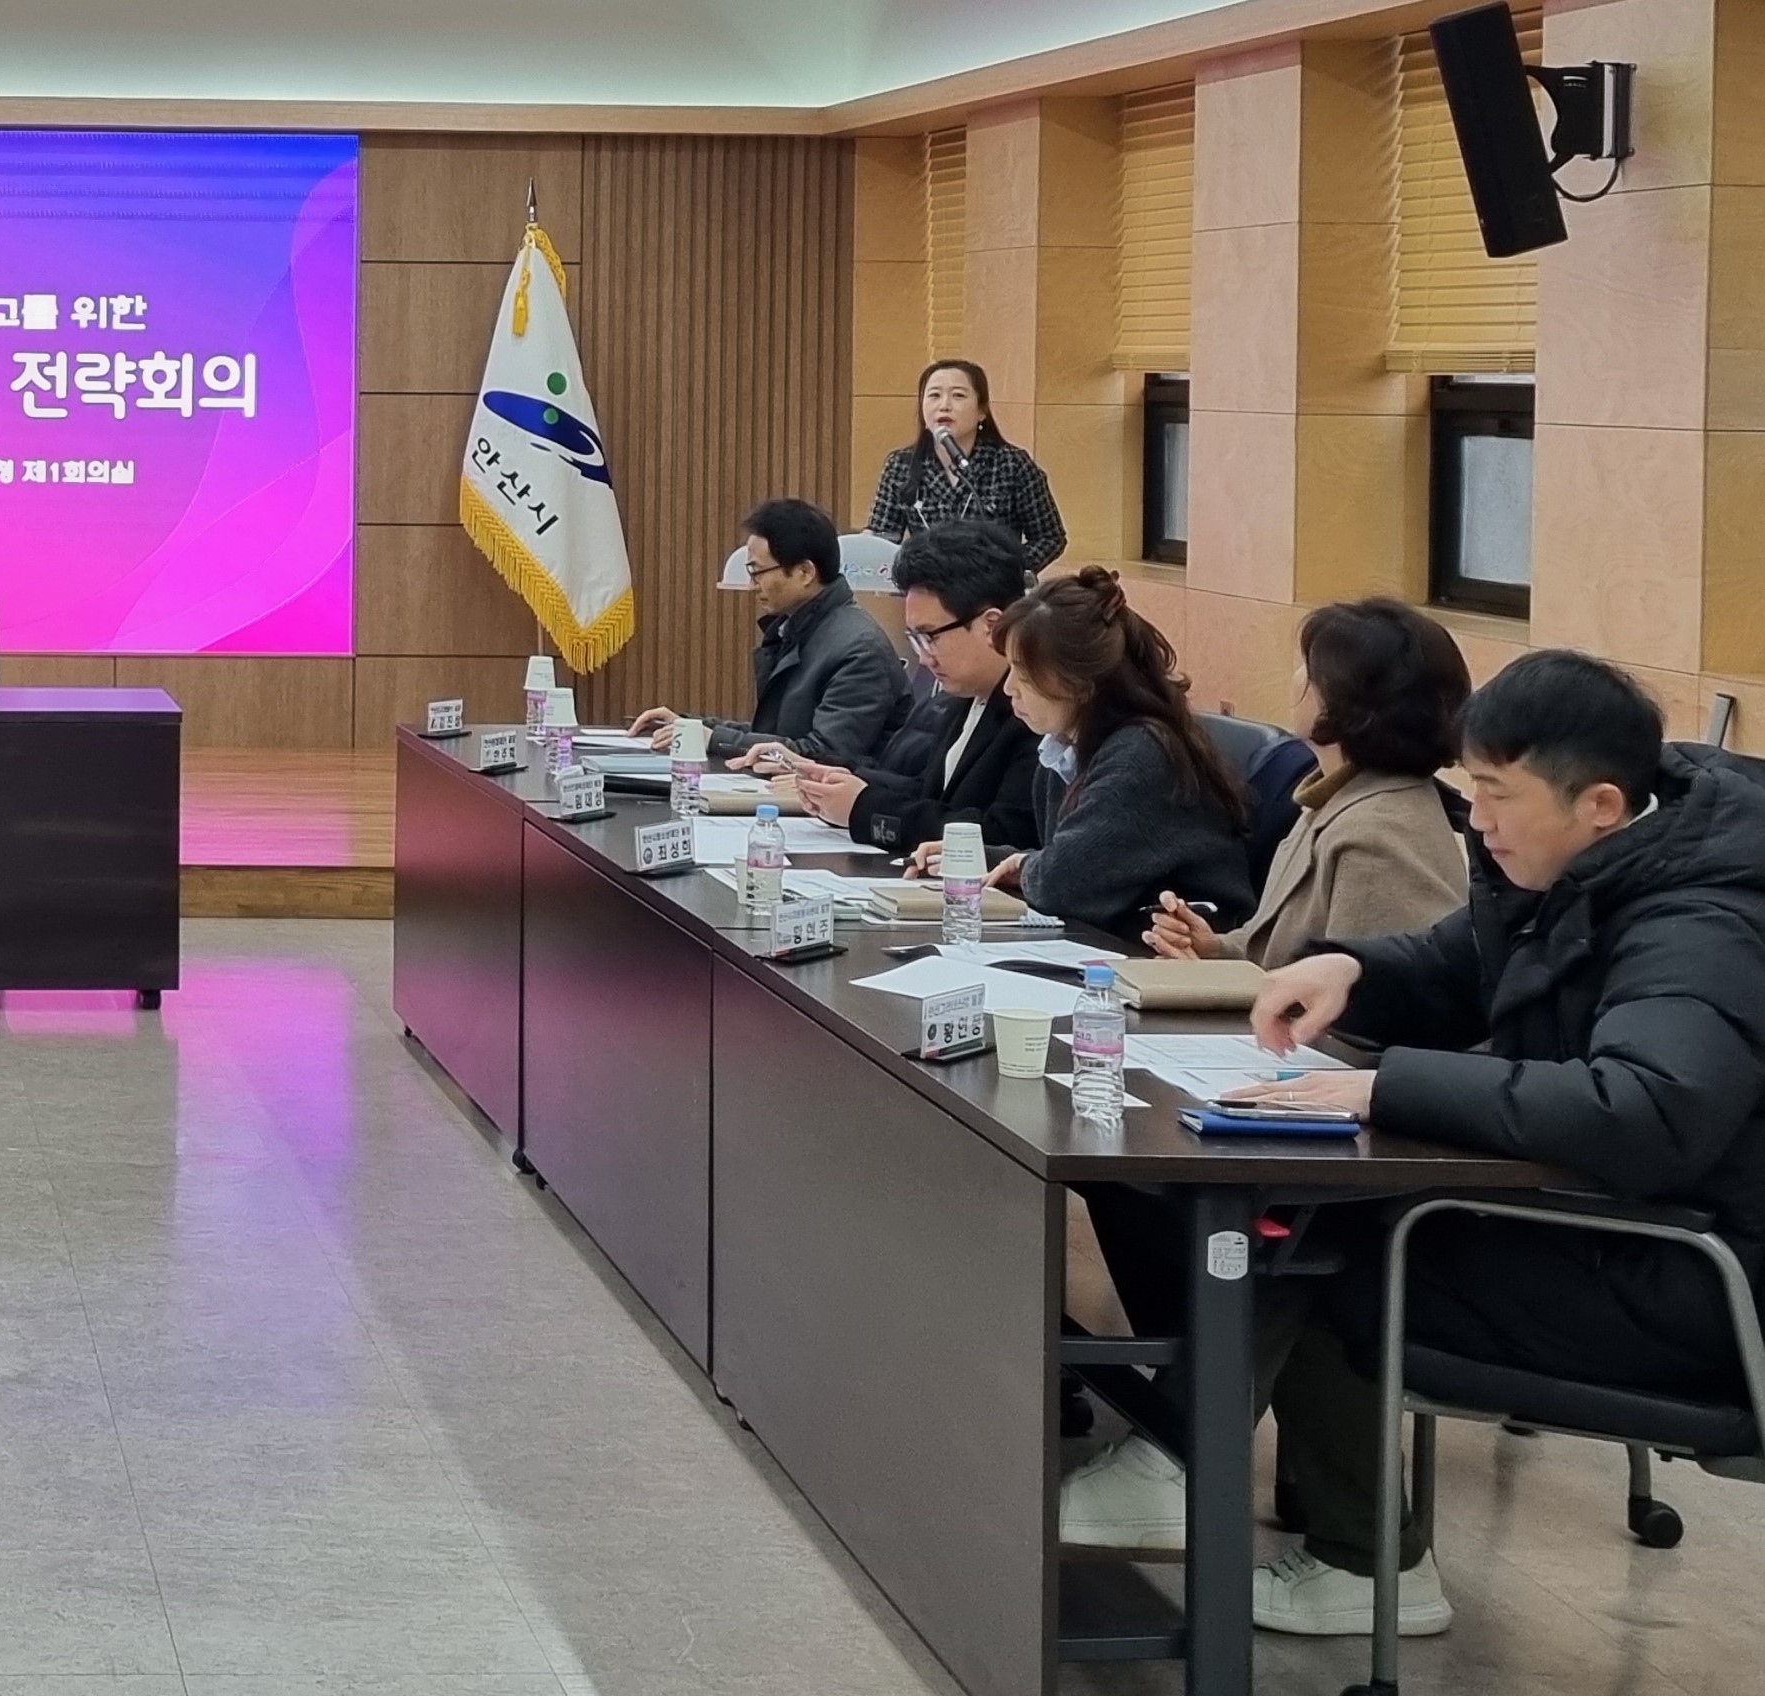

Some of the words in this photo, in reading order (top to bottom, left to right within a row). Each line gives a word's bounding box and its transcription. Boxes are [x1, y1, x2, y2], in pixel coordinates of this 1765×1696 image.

[70, 295, 149, 331] 위한
[9, 352, 257, 421] 전략회의
[21, 459, 135, 484] 제1회의실
[471, 437, 560, 537] 안산시
[657, 838, 692, 861] 최성희
